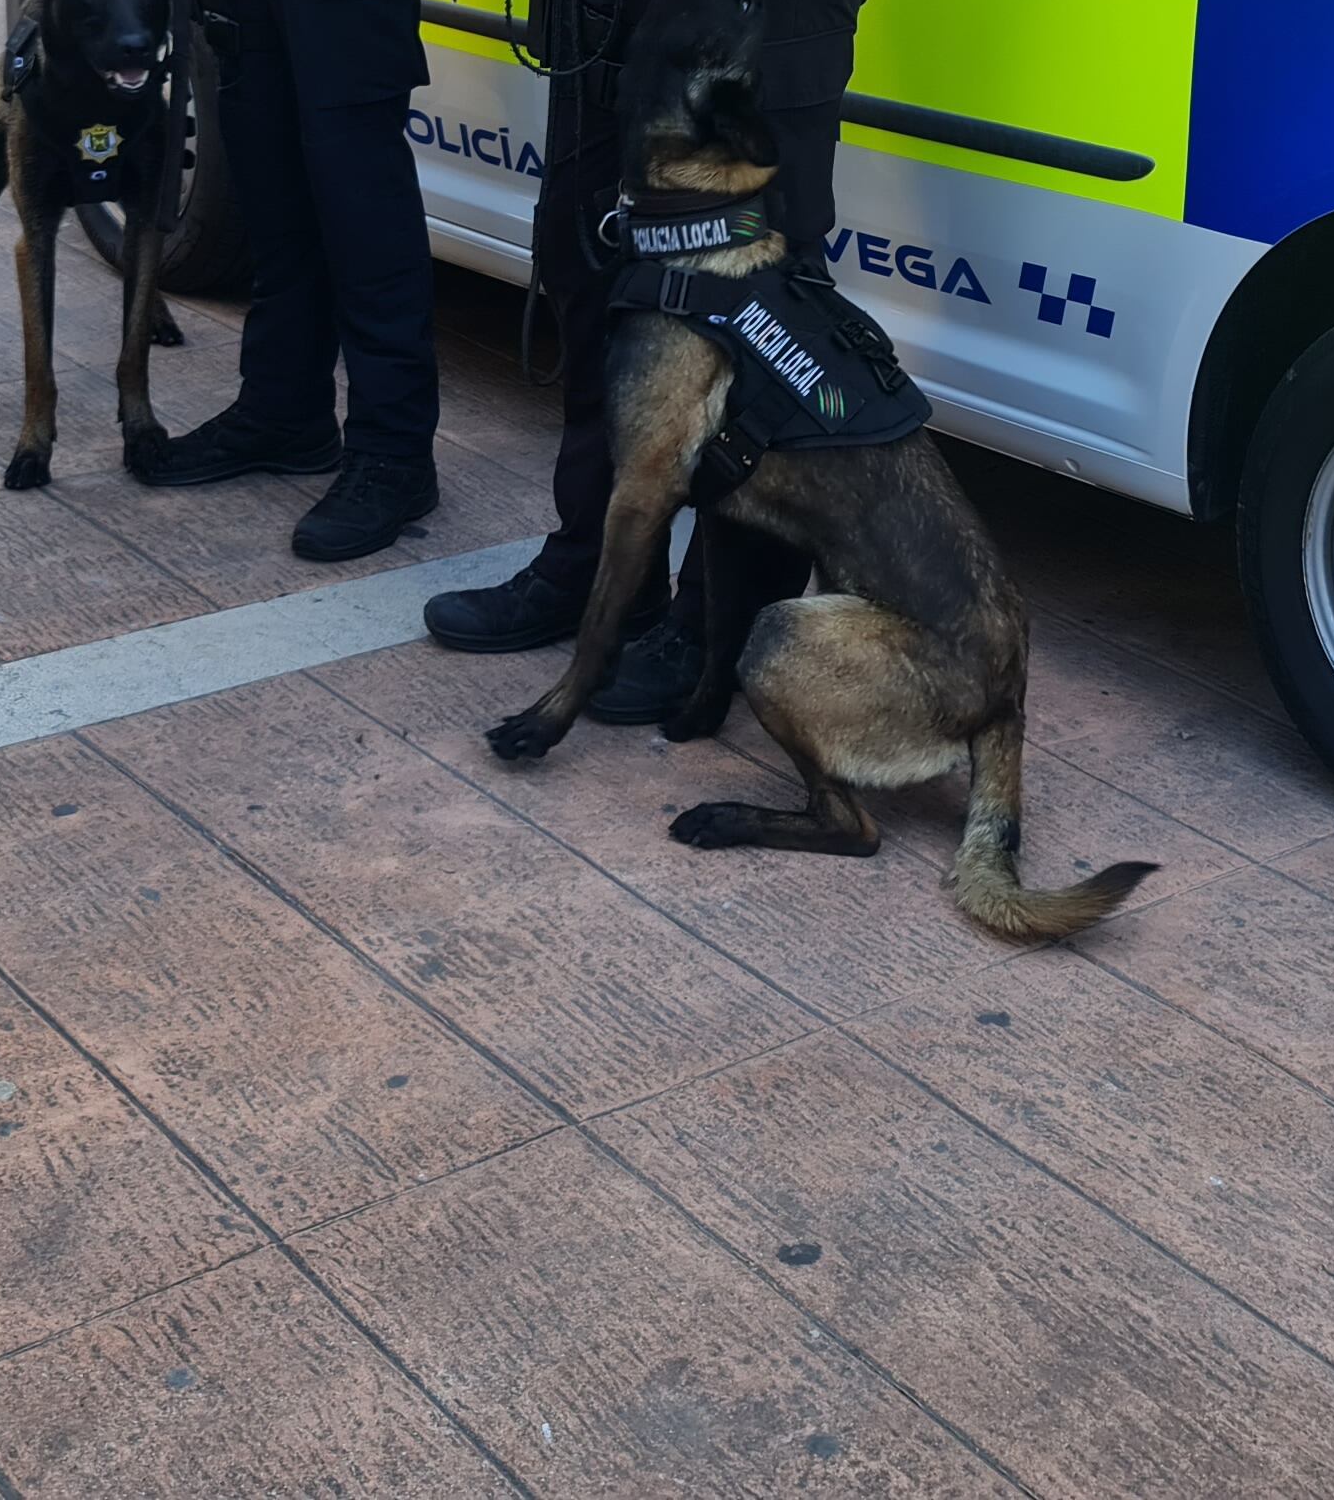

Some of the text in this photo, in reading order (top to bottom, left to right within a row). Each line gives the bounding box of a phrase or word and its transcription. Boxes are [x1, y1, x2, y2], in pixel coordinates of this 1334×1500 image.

[406, 108, 546, 179] OLICÍA
[682, 217, 731, 250] LOCAL
[824, 228, 992, 305] VEGA
[732, 300, 825, 397] POLICIA LOCAL
